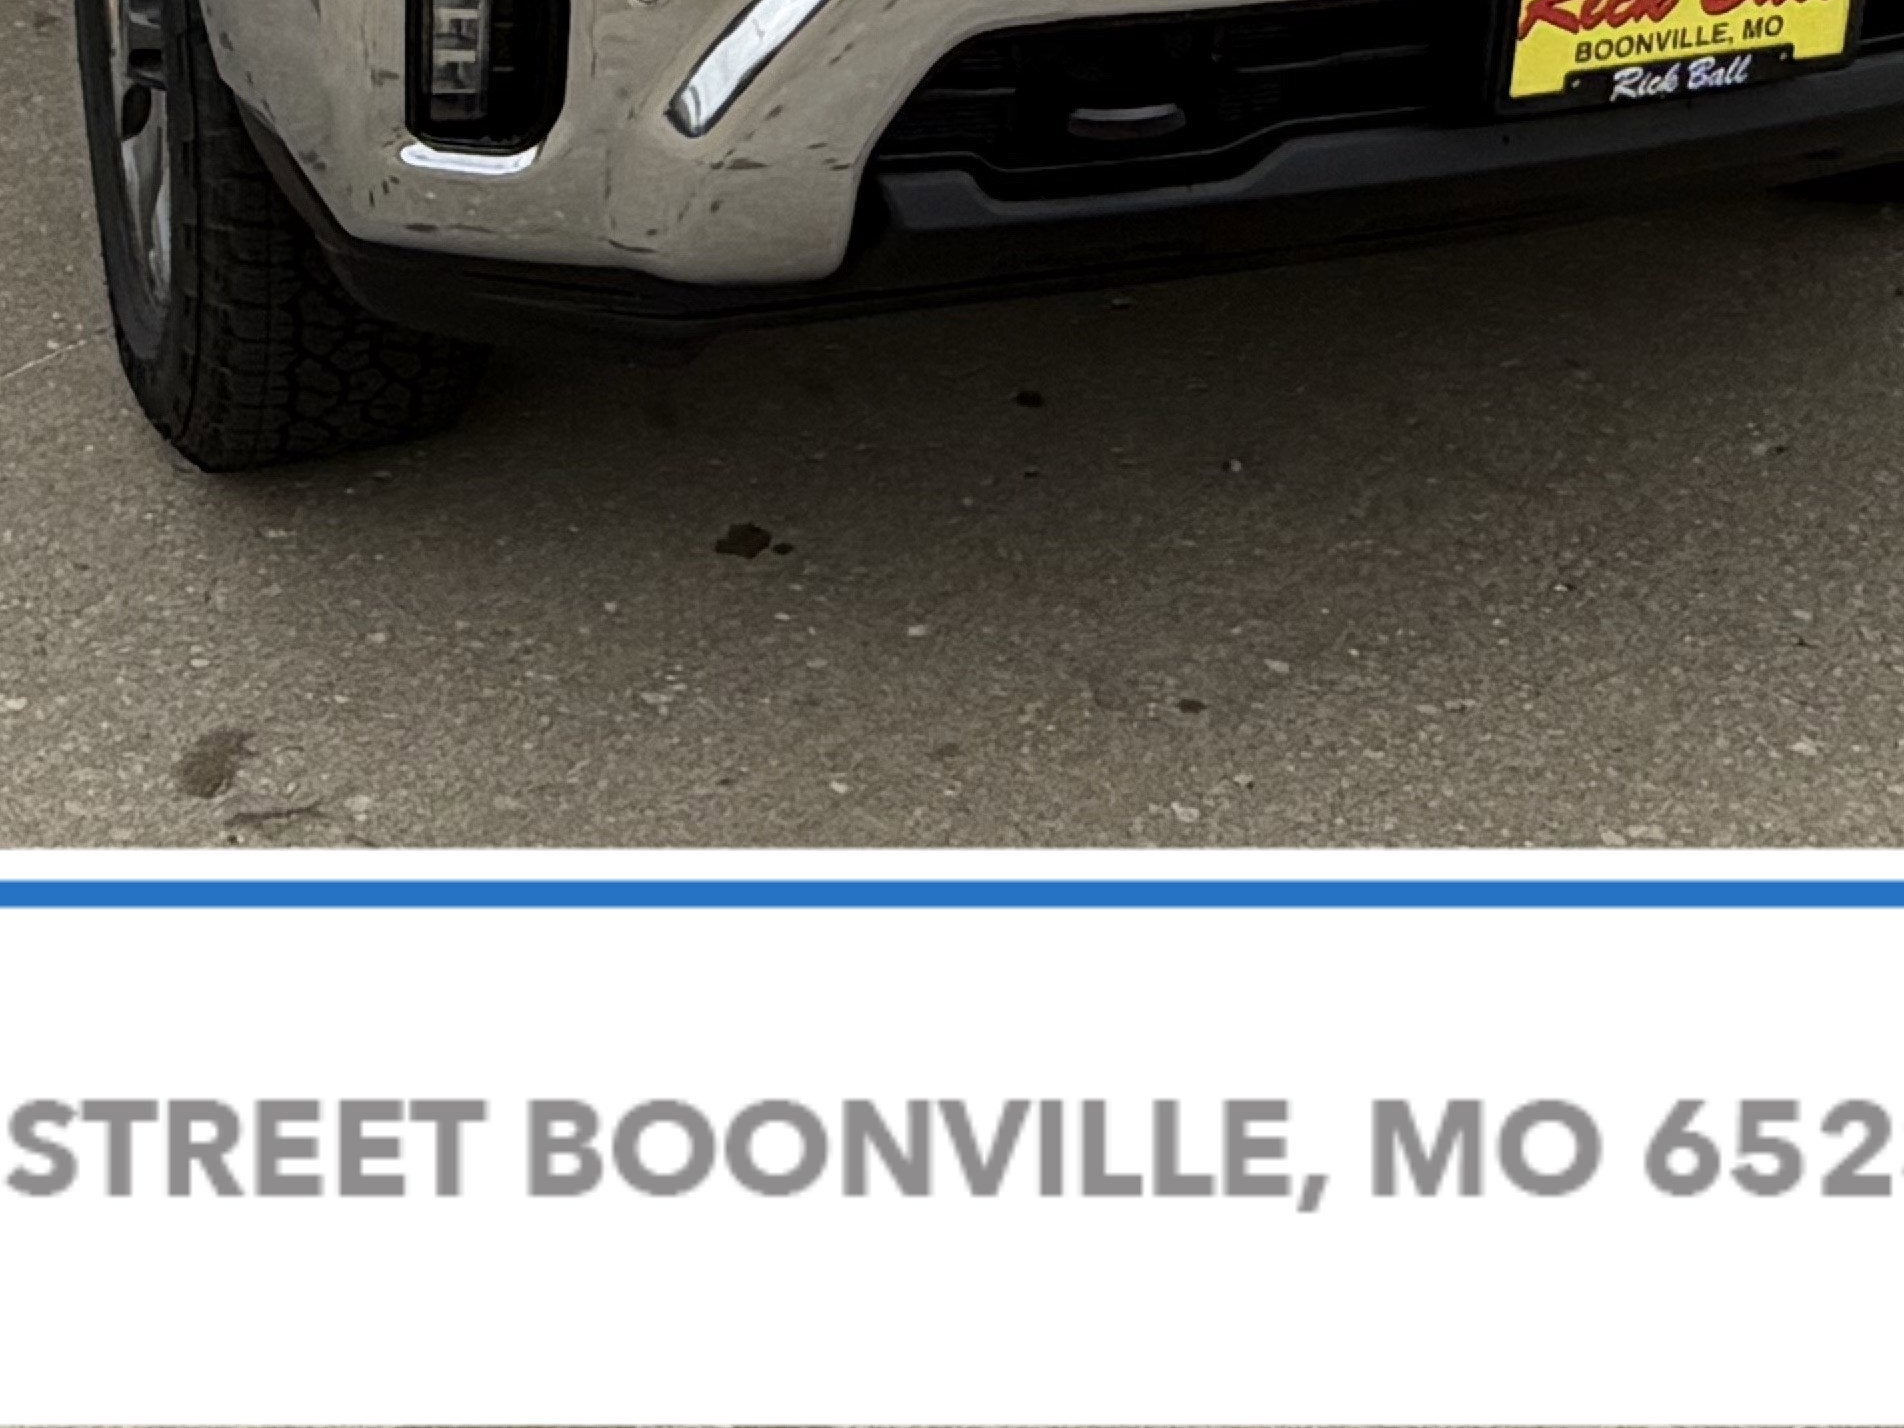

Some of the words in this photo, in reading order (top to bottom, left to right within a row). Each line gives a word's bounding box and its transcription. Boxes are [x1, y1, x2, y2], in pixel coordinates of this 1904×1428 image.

[1574, 21, 1735, 63] BOONVILLE,
[1743, 14, 1784, 40] MO
[1609, 61, 1679, 102] Rick
[1687, 54, 1752, 89] Ball
